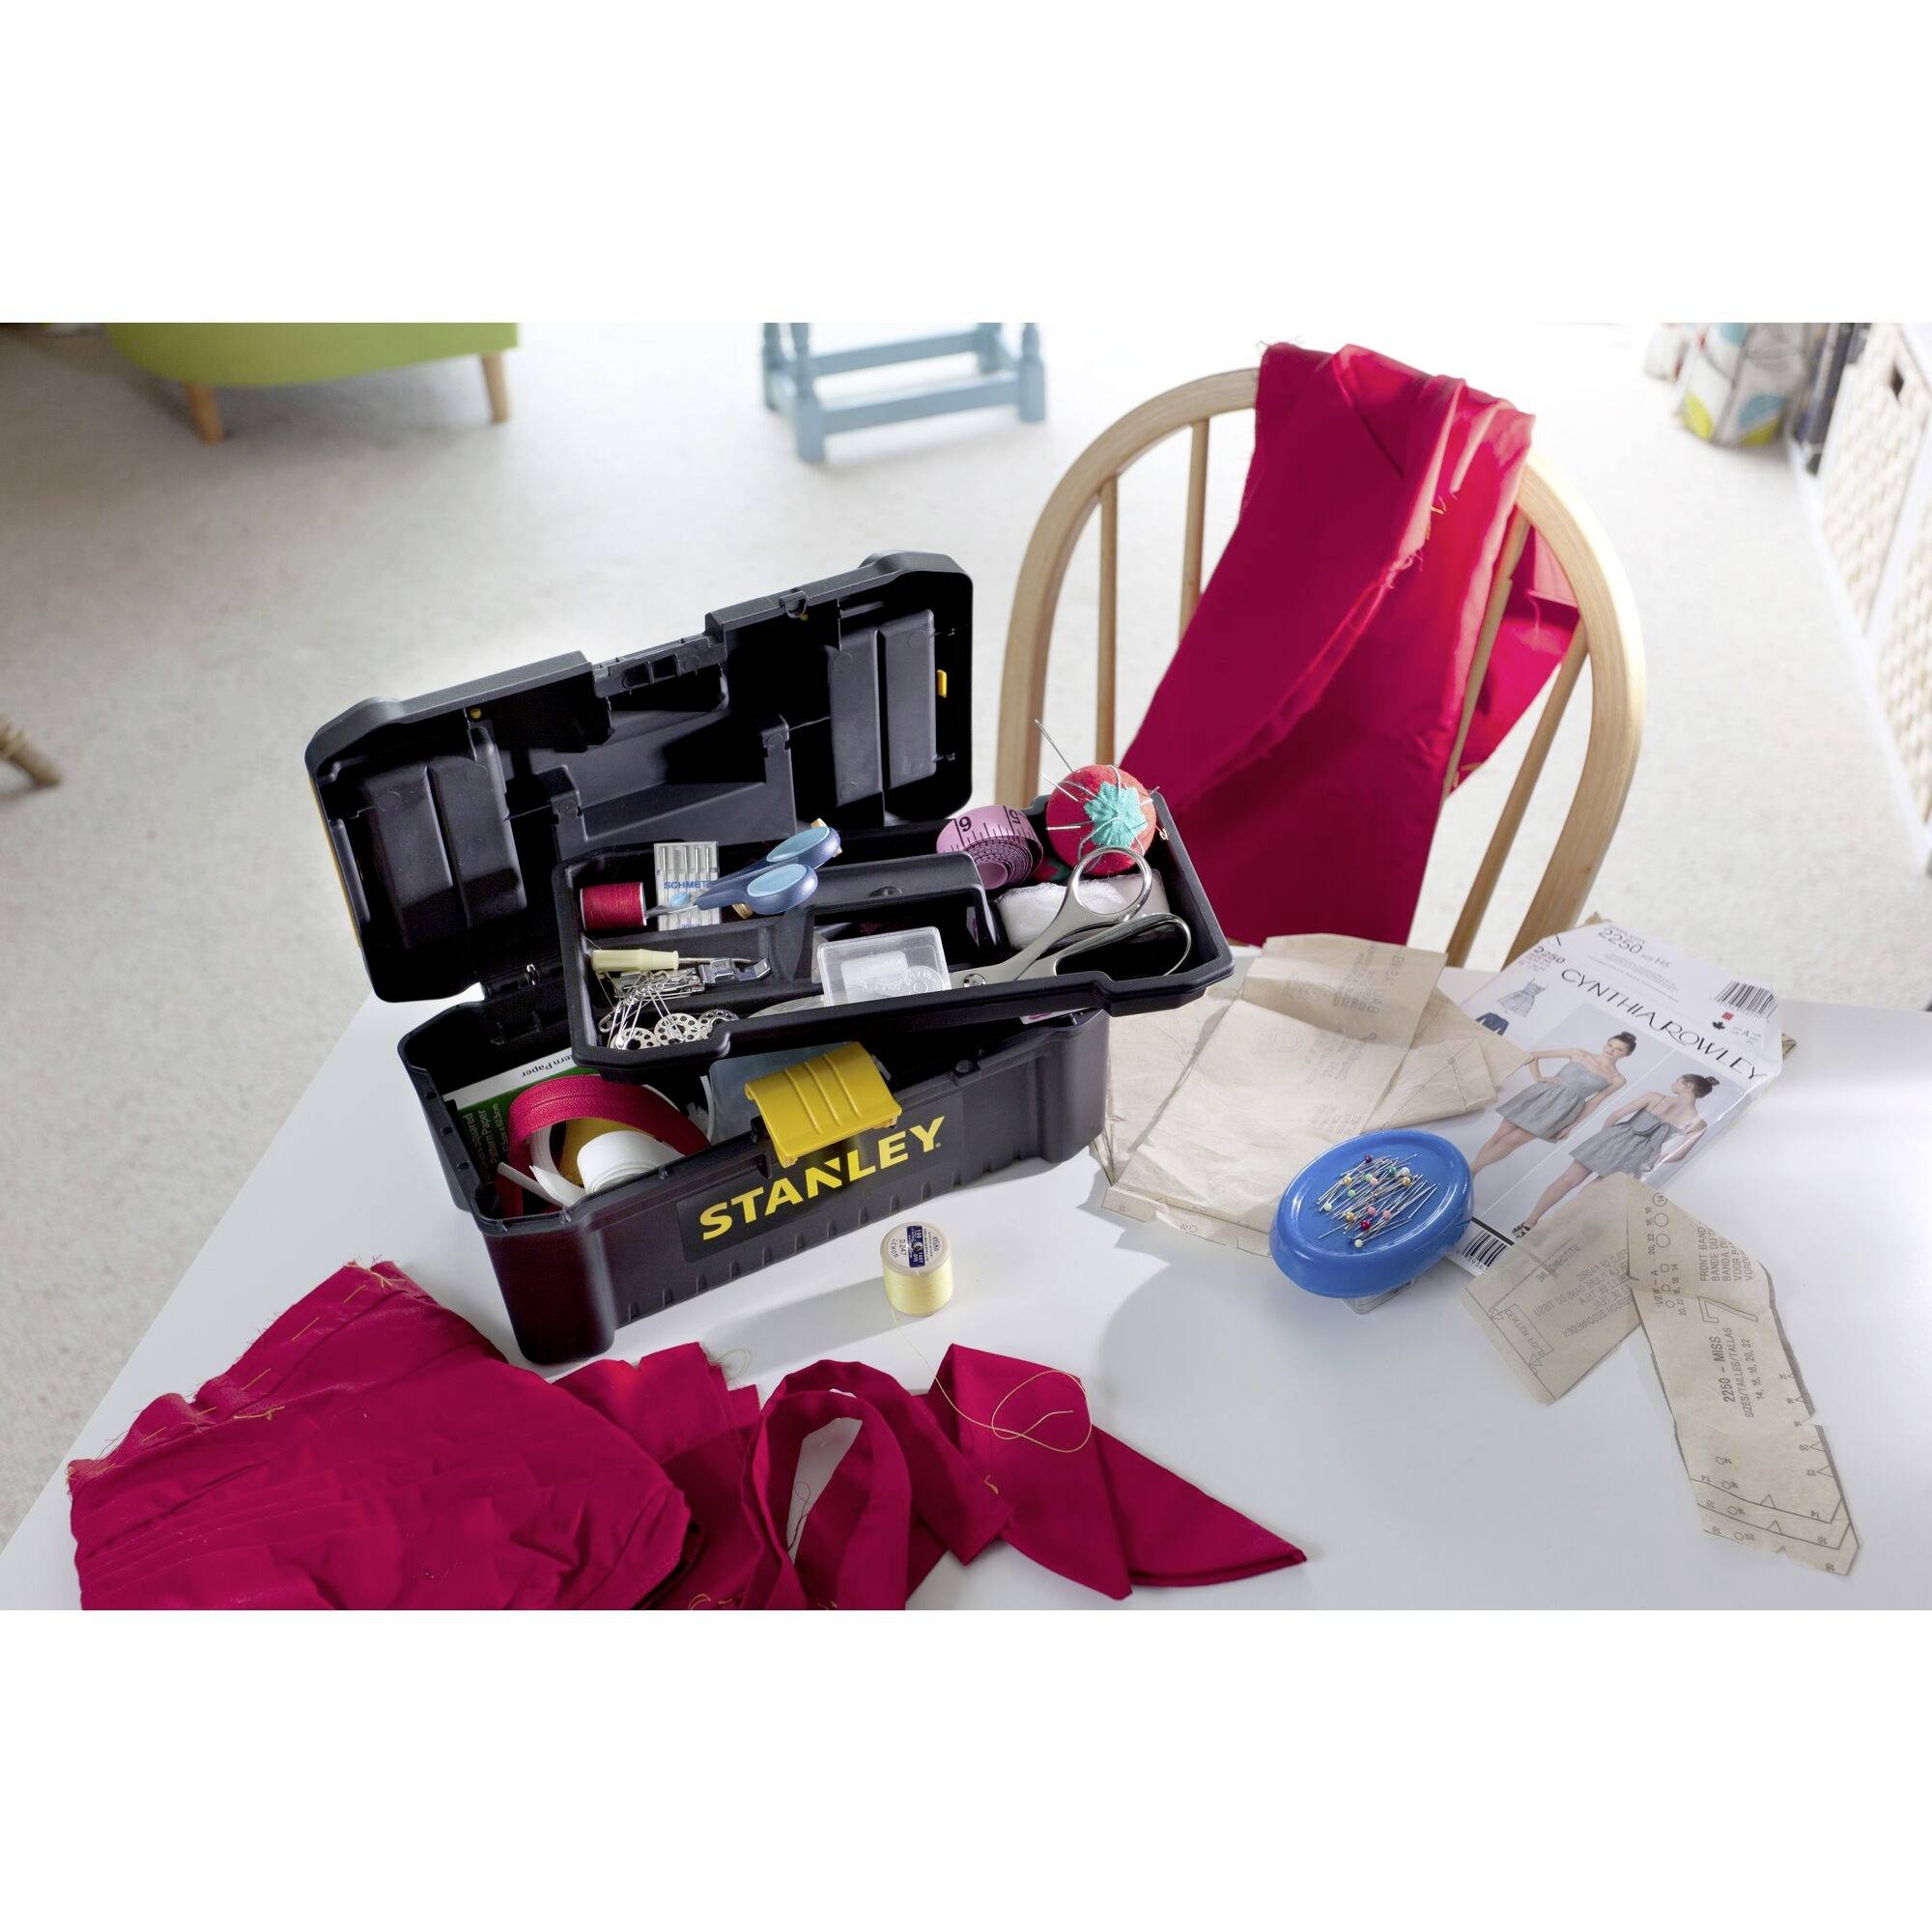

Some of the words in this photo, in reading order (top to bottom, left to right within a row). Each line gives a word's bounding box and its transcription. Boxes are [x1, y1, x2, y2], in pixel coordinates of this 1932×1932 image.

[1599, 927, 1643, 954] 2250
[1534, 946, 1566, 964] 2250
[1561, 968, 1661, 1031] CYNTHIA
[1661, 1021, 1768, 1079] ROWLEY
[522, 1063, 553, 1078] Paper
[699, 1116, 945, 1240] STANLEY
[1697, 1227, 1708, 1251] BAND
[1709, 1237, 1719, 1250] DU
[1699, 1254, 1709, 1282] FRONT
[1711, 1253, 1720, 1282] BANDE
[1721, 1252, 1732, 1282] BANDA
[1732, 1256, 1743, 1282] VOOR
[1709, 1336, 1725, 1363] MISS
[1742, 1338, 1750, 1349] 22
[1725, 1327, 1755, 1418] SIZES/TAILLES/TALLAS
[1719, 1378, 1736, 1403] 2250
